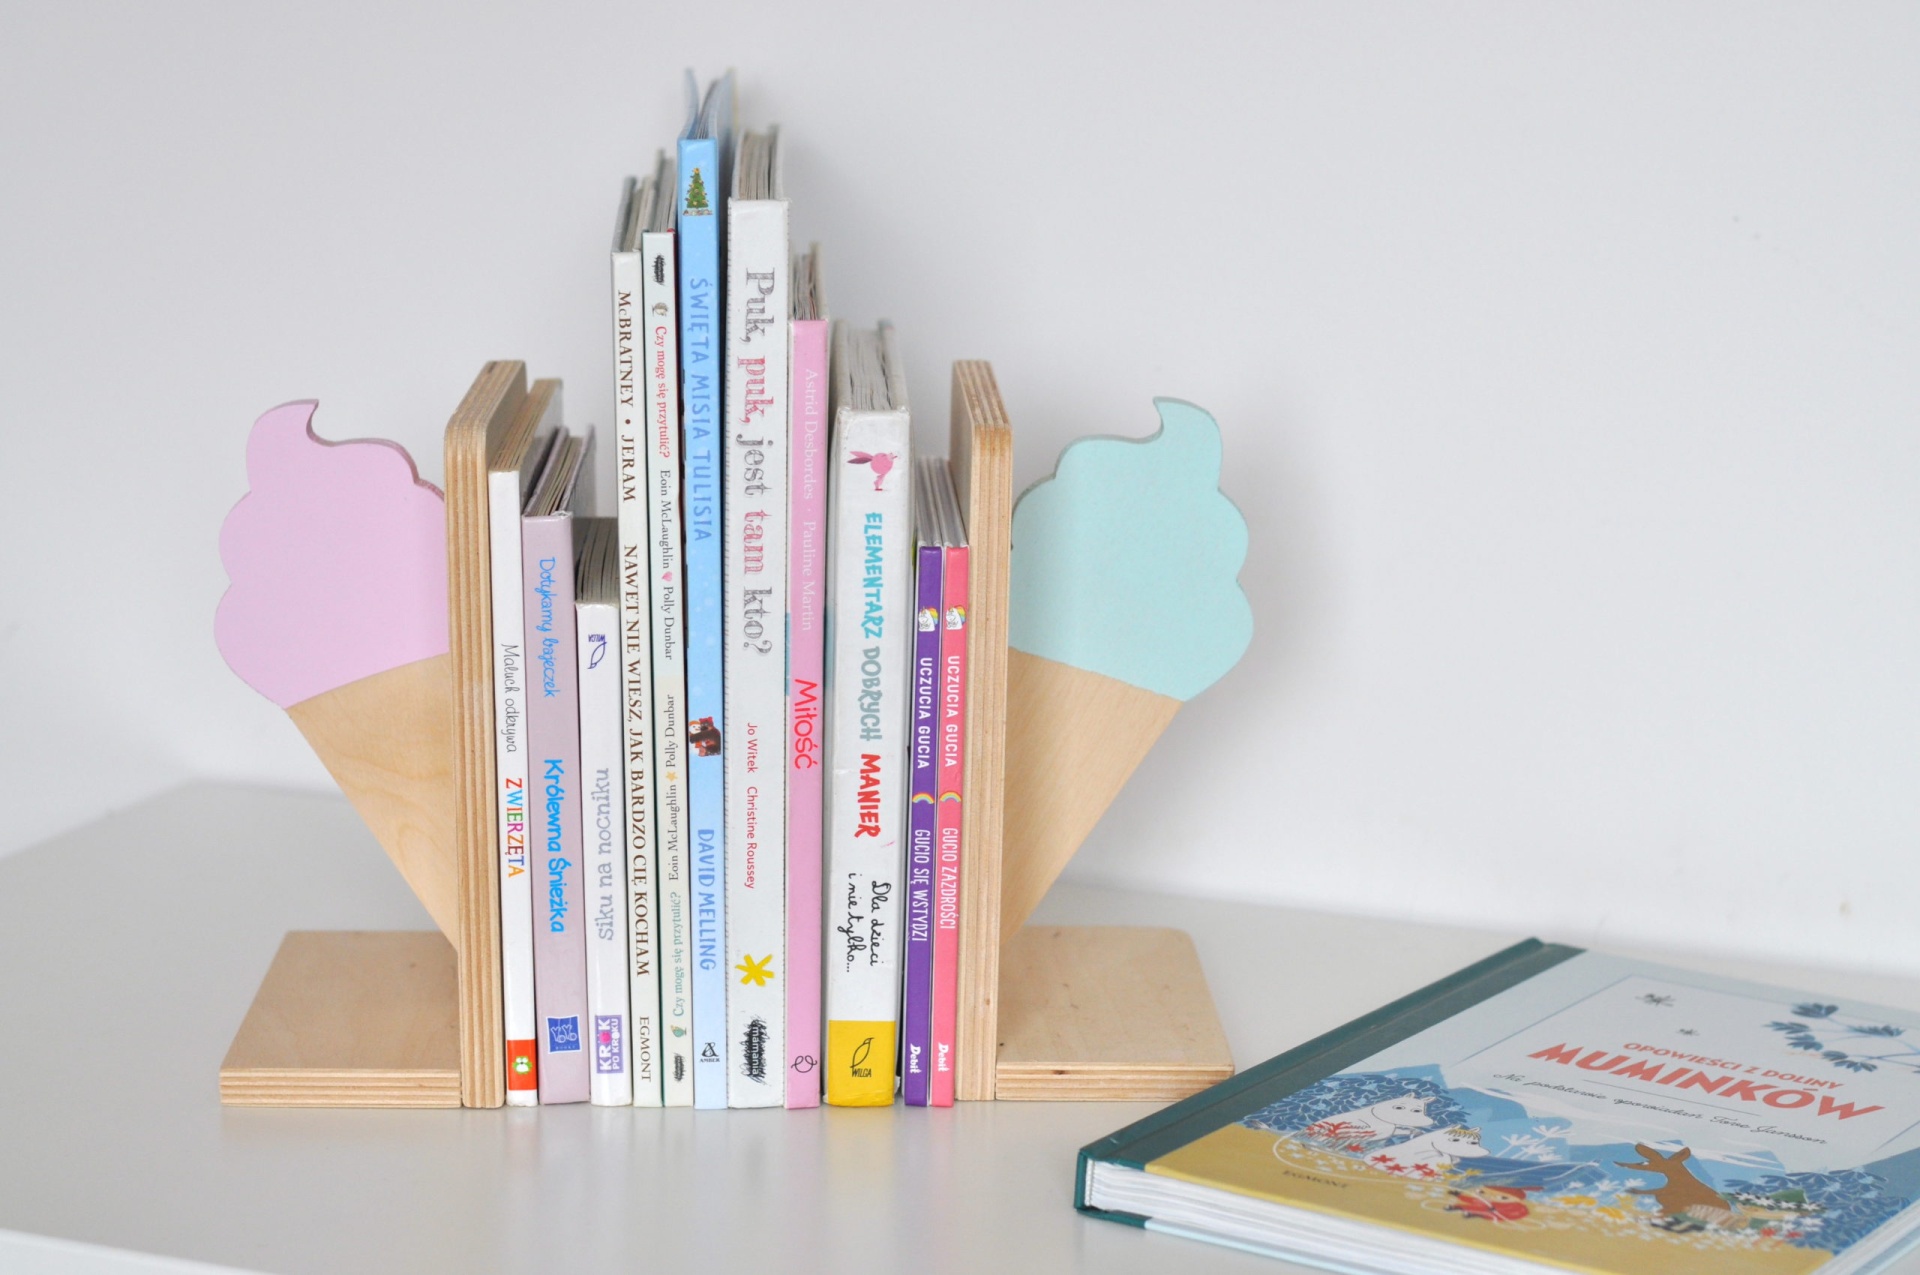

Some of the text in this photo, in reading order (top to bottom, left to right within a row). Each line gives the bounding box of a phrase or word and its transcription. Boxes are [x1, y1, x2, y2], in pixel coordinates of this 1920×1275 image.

[617, 290, 637, 502] McBRATNEY JERAM
[654, 325, 671, 459] Czy mogę się przytulić?
[687, 278, 713, 541] ŚWIĘTA MISIA TULISIA
[736, 267, 775, 654] Puk, puk, jest tam kto?
[802, 368, 819, 631] Astrid Desbordes Pauline Martin
[659, 469, 675, 660] Eoin McLaughlin Polly Dunbar
[860, 512, 884, 639] ELEMENTARZ
[534, 556, 560, 698] Dotykamy bajeczek
[501, 643, 521, 753] Maluch odkrywa
[794, 678, 818, 769] Miłość
[917, 657, 933, 769] UCZUCIA GUCIA
[944, 655, 960, 767] UCZUCIA GUCIA
[624, 543, 650, 978] NAWET NIE WIESZ, JAK BARDZO CIĘ KOCHAM
[663, 694, 681, 881] Dunbar Polly McLaughlin Eoin
[744, 722, 758, 889] Jo Witek Christine Roussey
[854, 753, 881, 838] MANIER
[505, 778, 525, 878] ZWIERZĘTA
[544, 759, 572, 933] Królewna Śnieżka
[597, 862, 612, 889] na
[940, 827, 960, 929] GUCIO ZAZDROŚCI
[697, 829, 716, 971] DAVID MELLING
[847, 882, 862, 909] nie
[870, 880, 892, 966] Dla dzieci
[910, 829, 931, 941] GUCIO SIĘ WSTYDZI
[669, 891, 685, 1017] Czy mogę się przytulić?
[611, 1055, 620, 1070] PO
[639, 1015, 652, 1082] EGMONT
[852, 1068, 872, 1078] WILGA
[909, 1043, 922, 1074] Debit
[937, 1042, 950, 1072] Debit
[1527, 1043, 1886, 1120] MUMINKÓW
[1623, 1042, 1845, 1090] OPOWIEŚCI Z DOLINY
